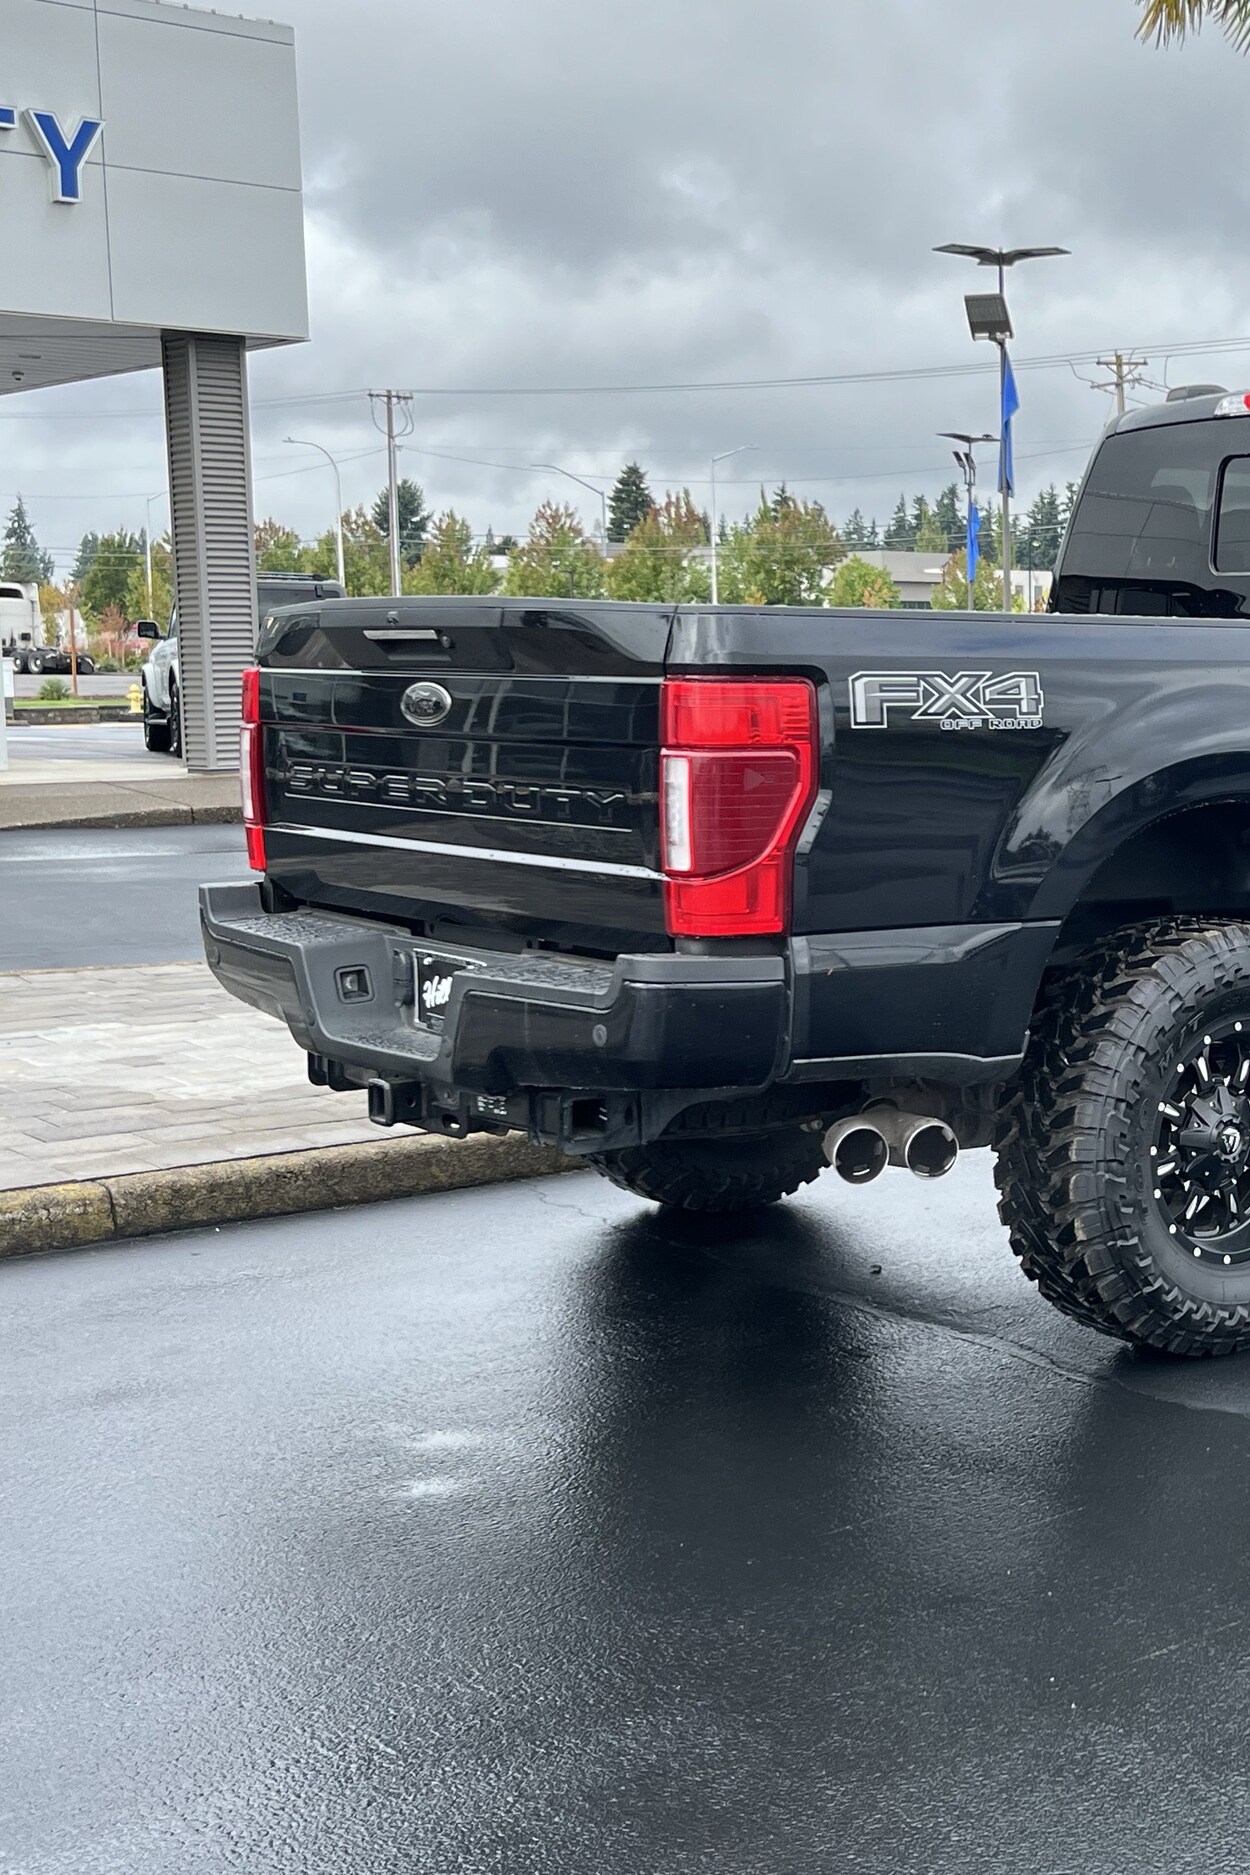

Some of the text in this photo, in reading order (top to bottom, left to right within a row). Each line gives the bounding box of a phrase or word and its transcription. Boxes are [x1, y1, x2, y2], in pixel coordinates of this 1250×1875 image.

[0, 105, 106, 203] Y
[848, 670, 1044, 729] FX4
[939, 717, 1043, 730] OFF ROAD
[288, 765, 626, 823] SUPER DUTY
